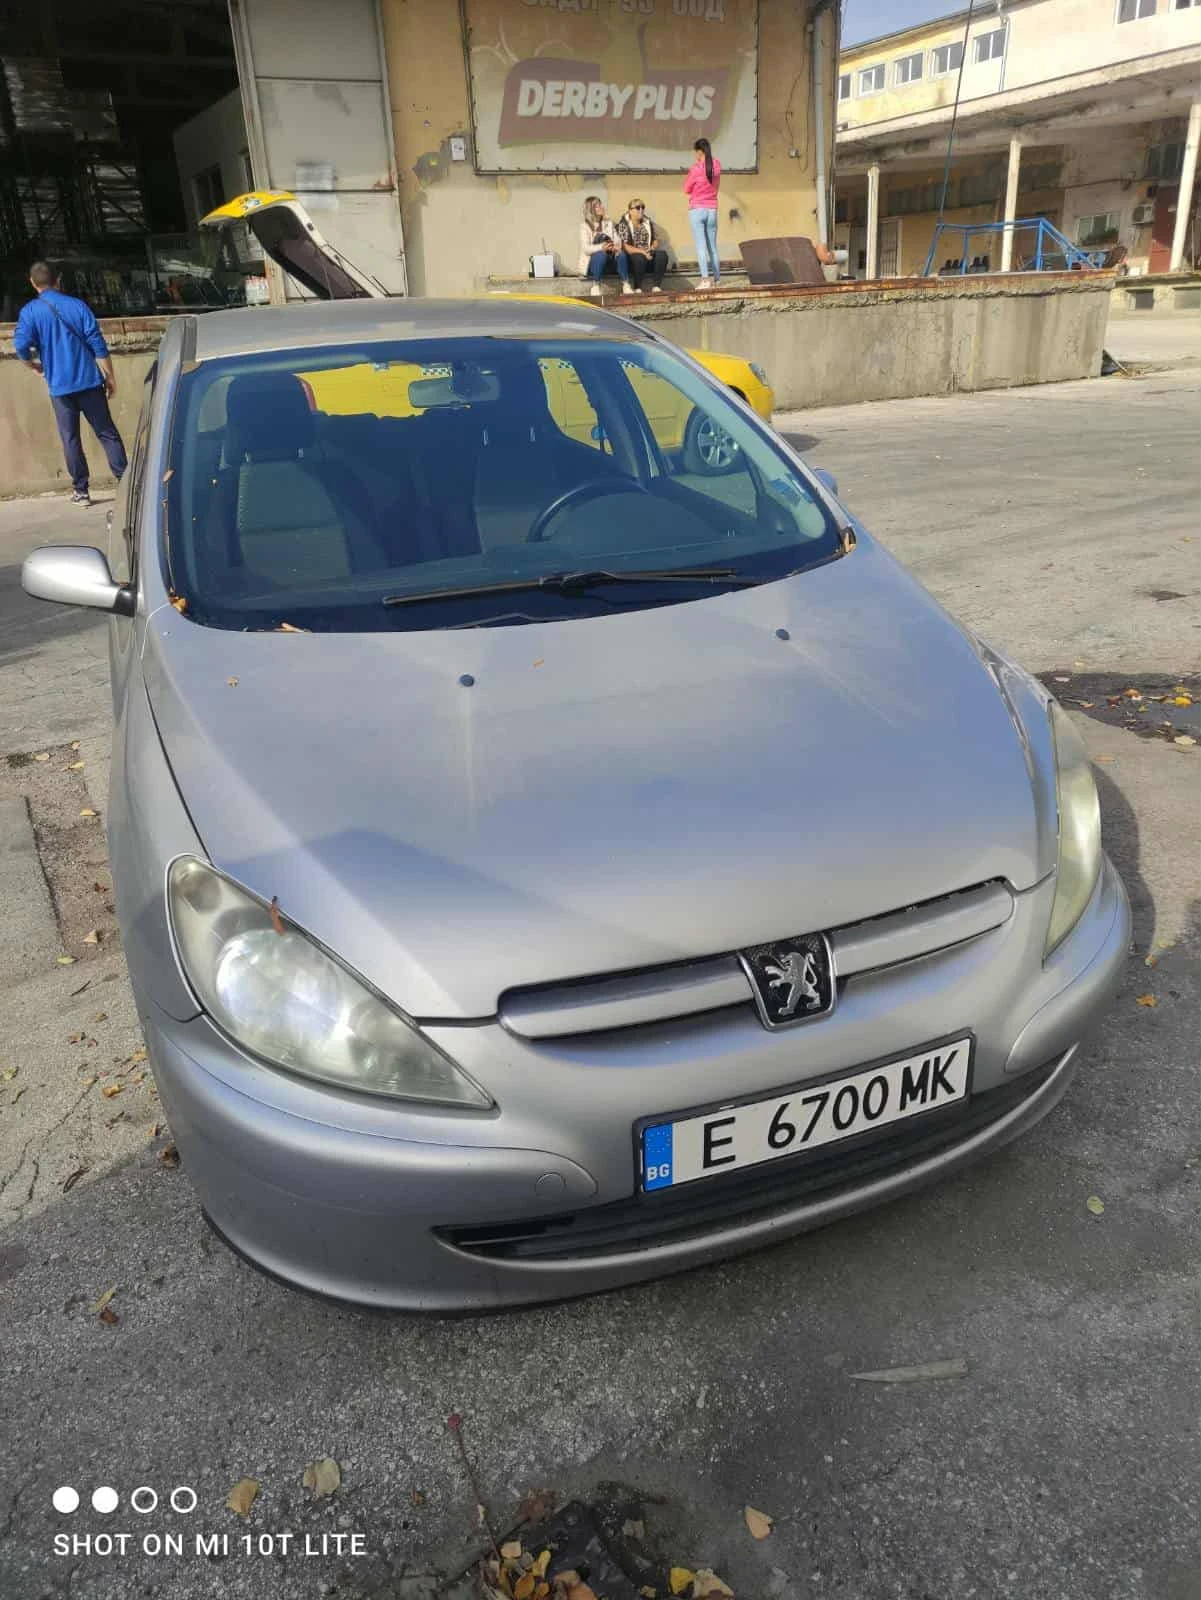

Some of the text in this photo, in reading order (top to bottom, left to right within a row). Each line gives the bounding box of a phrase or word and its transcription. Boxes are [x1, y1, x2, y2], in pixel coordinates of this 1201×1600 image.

[517, 79, 716, 121] DERBY PLUS
[703, 1050, 959, 1169] E 6700 MK
[647, 1163, 670, 1181] BG
